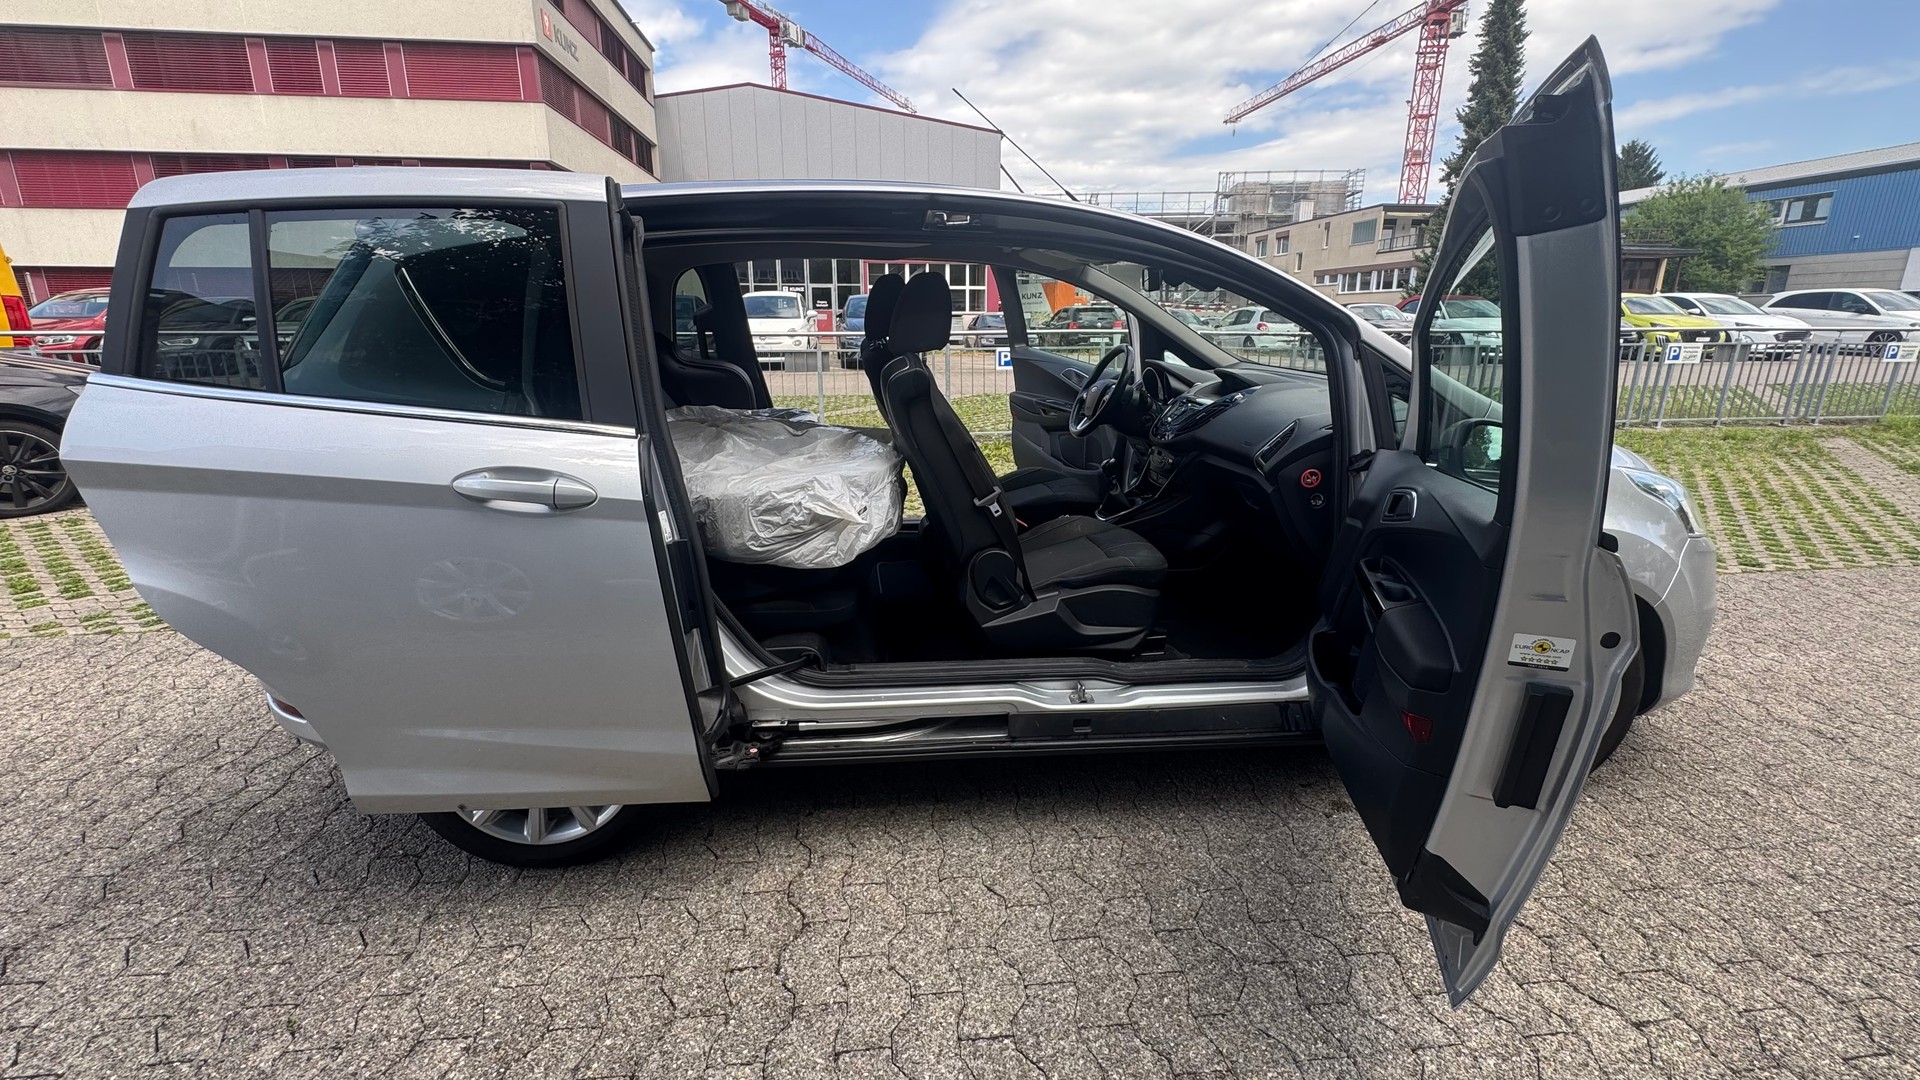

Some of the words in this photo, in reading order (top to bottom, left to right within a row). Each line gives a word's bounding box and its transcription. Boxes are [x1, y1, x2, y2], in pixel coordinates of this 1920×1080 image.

[553, 24, 579, 62] KUNZ
[1021, 292, 1043, 300] KUNZ
[1669, 347, 1680, 360] P
[1887, 346, 1898, 358] P
[1001, 352, 1010, 366] P
